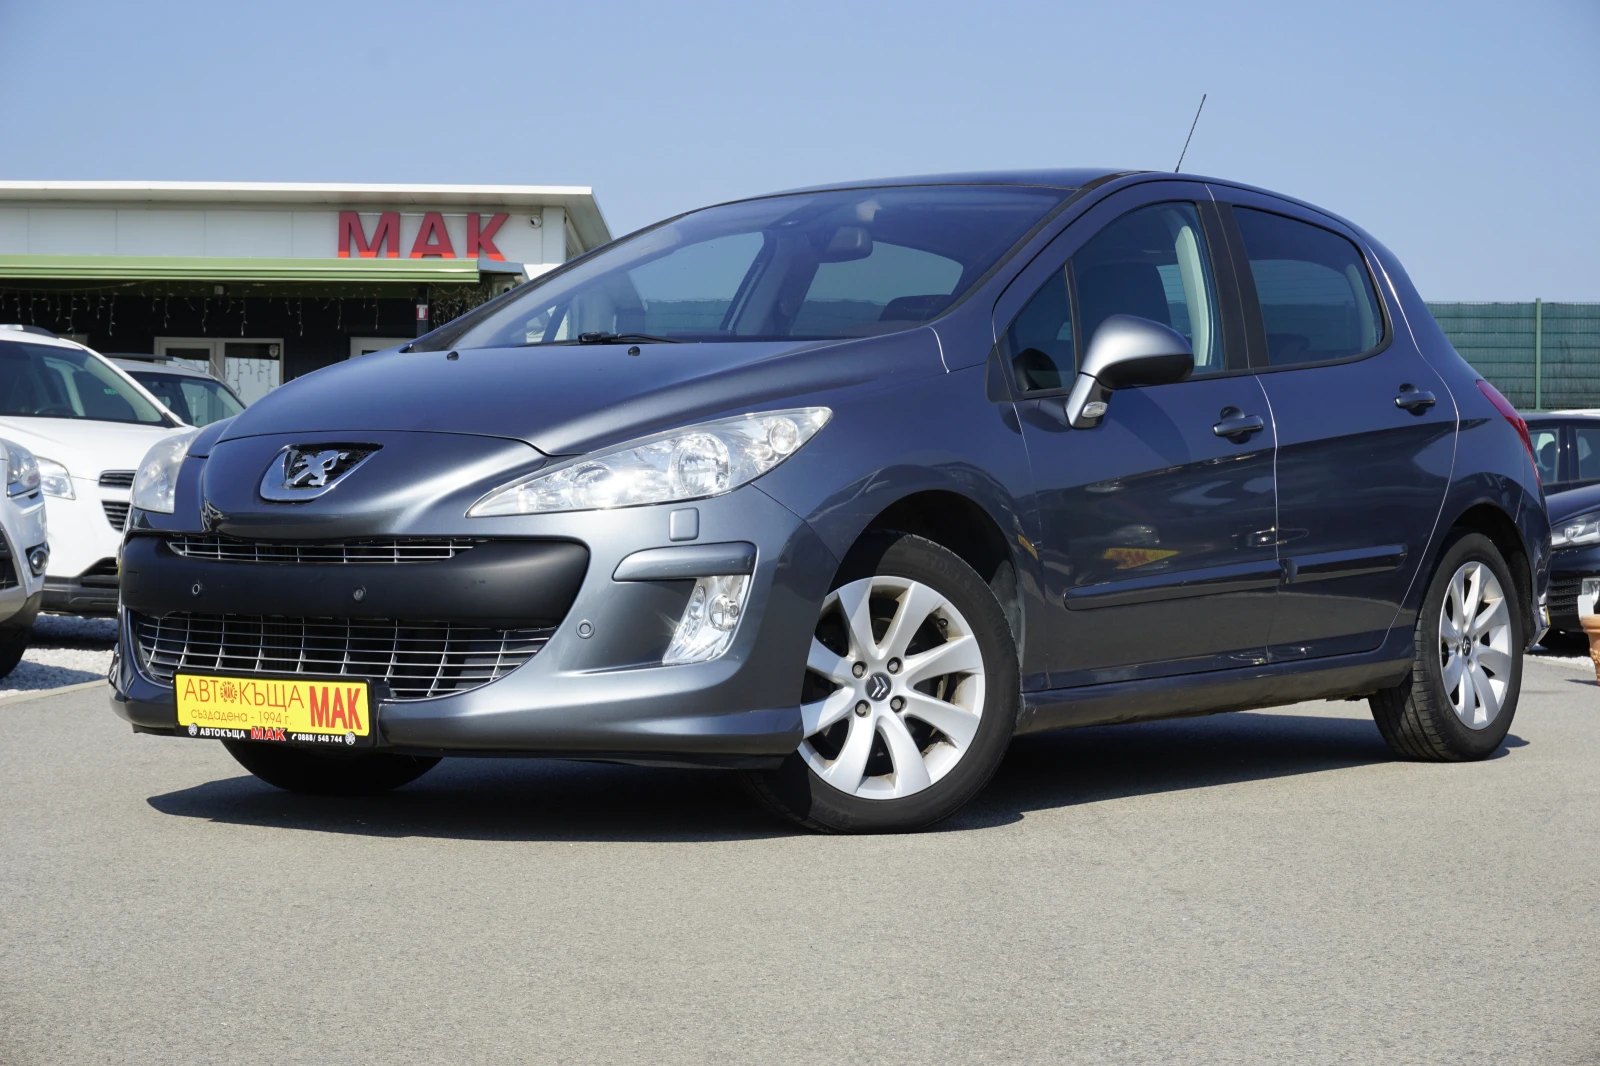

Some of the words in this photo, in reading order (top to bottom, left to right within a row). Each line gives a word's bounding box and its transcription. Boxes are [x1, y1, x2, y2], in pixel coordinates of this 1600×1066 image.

[338, 210, 510, 262] МАК
[259, 711, 282, 725] 1994
[309, 686, 362, 730] МАК
[200, 727, 246, 740] АВТОКЪЩА
[250, 726, 287, 741] МАК
[331, 735, 343, 743] 744
